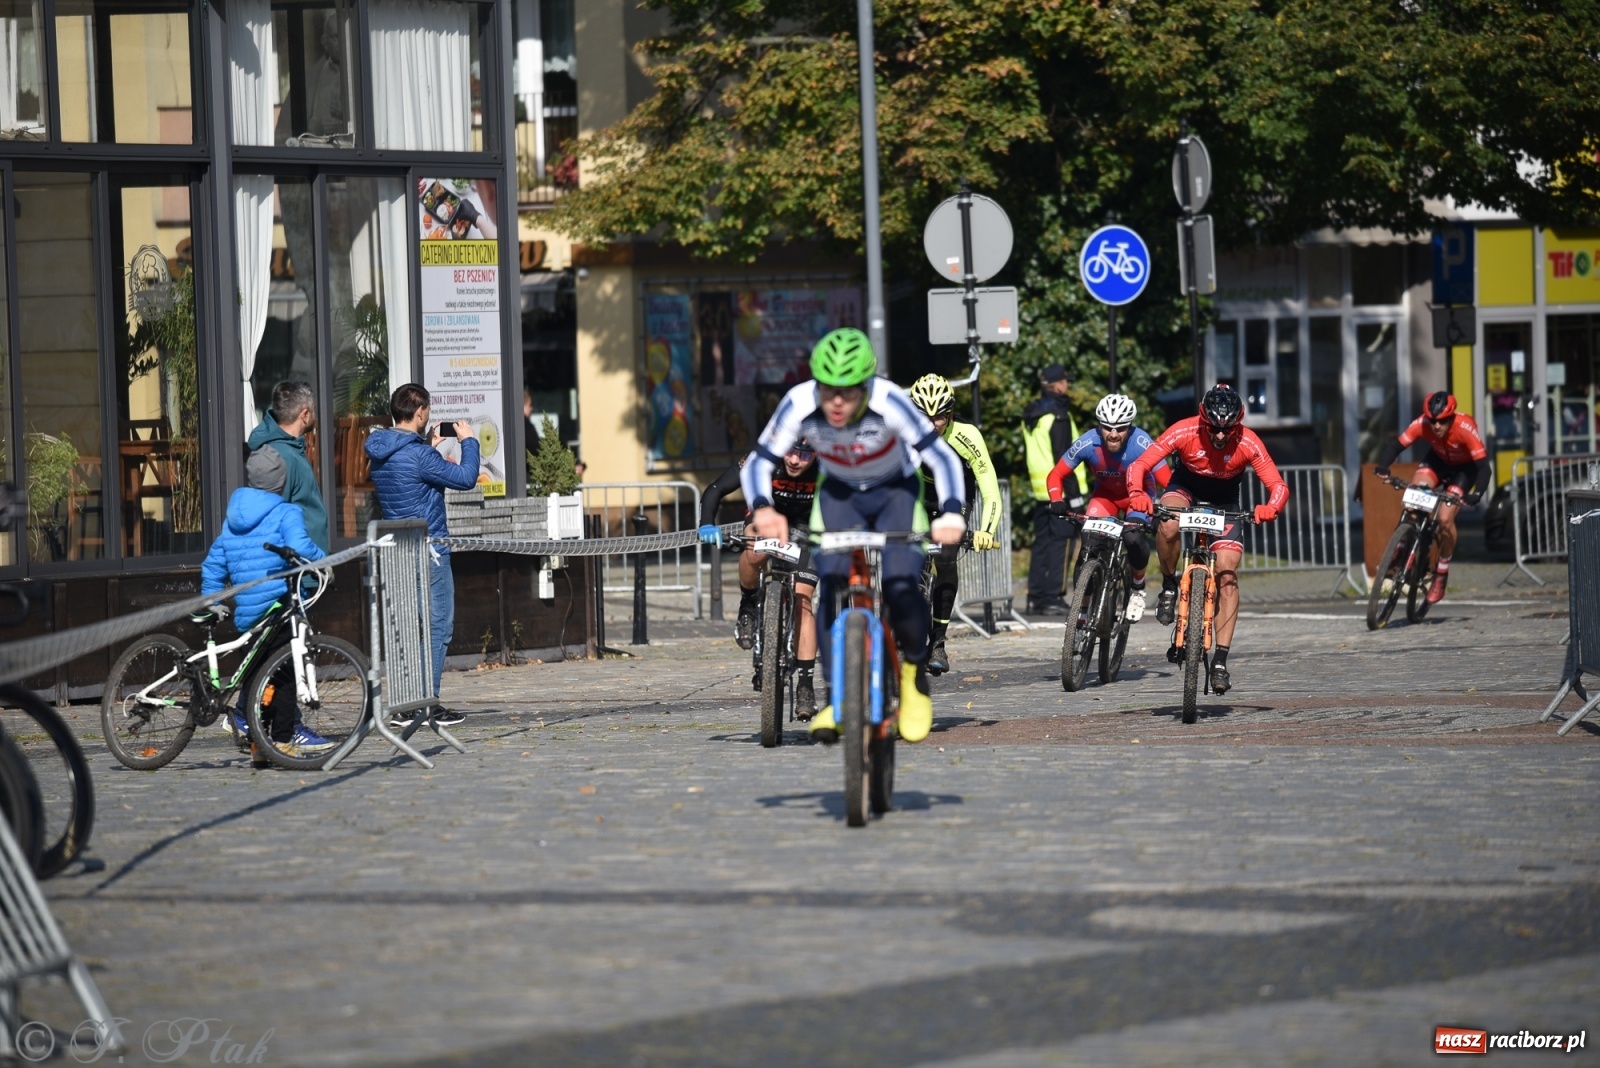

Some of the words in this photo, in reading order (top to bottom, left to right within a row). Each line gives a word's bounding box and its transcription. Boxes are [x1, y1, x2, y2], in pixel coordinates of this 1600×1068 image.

[422, 244, 452, 264] CATERING
[454, 244, 496, 264] DIETETYCZNY
[454, 270, 465, 282] BEZ
[467, 270, 496, 282] PSZENICY
[425, 315, 443, 326] ZDROWA
[447, 315, 480, 325] ZBILANSOWANA
[447, 395, 463, 404] DOBRYM
[464, 394, 485, 404] GLUTENEM
[958, 432, 982, 458] HEAD
[1188, 516, 1216, 526] 1628
[1091, 522, 1116, 532] 1177
